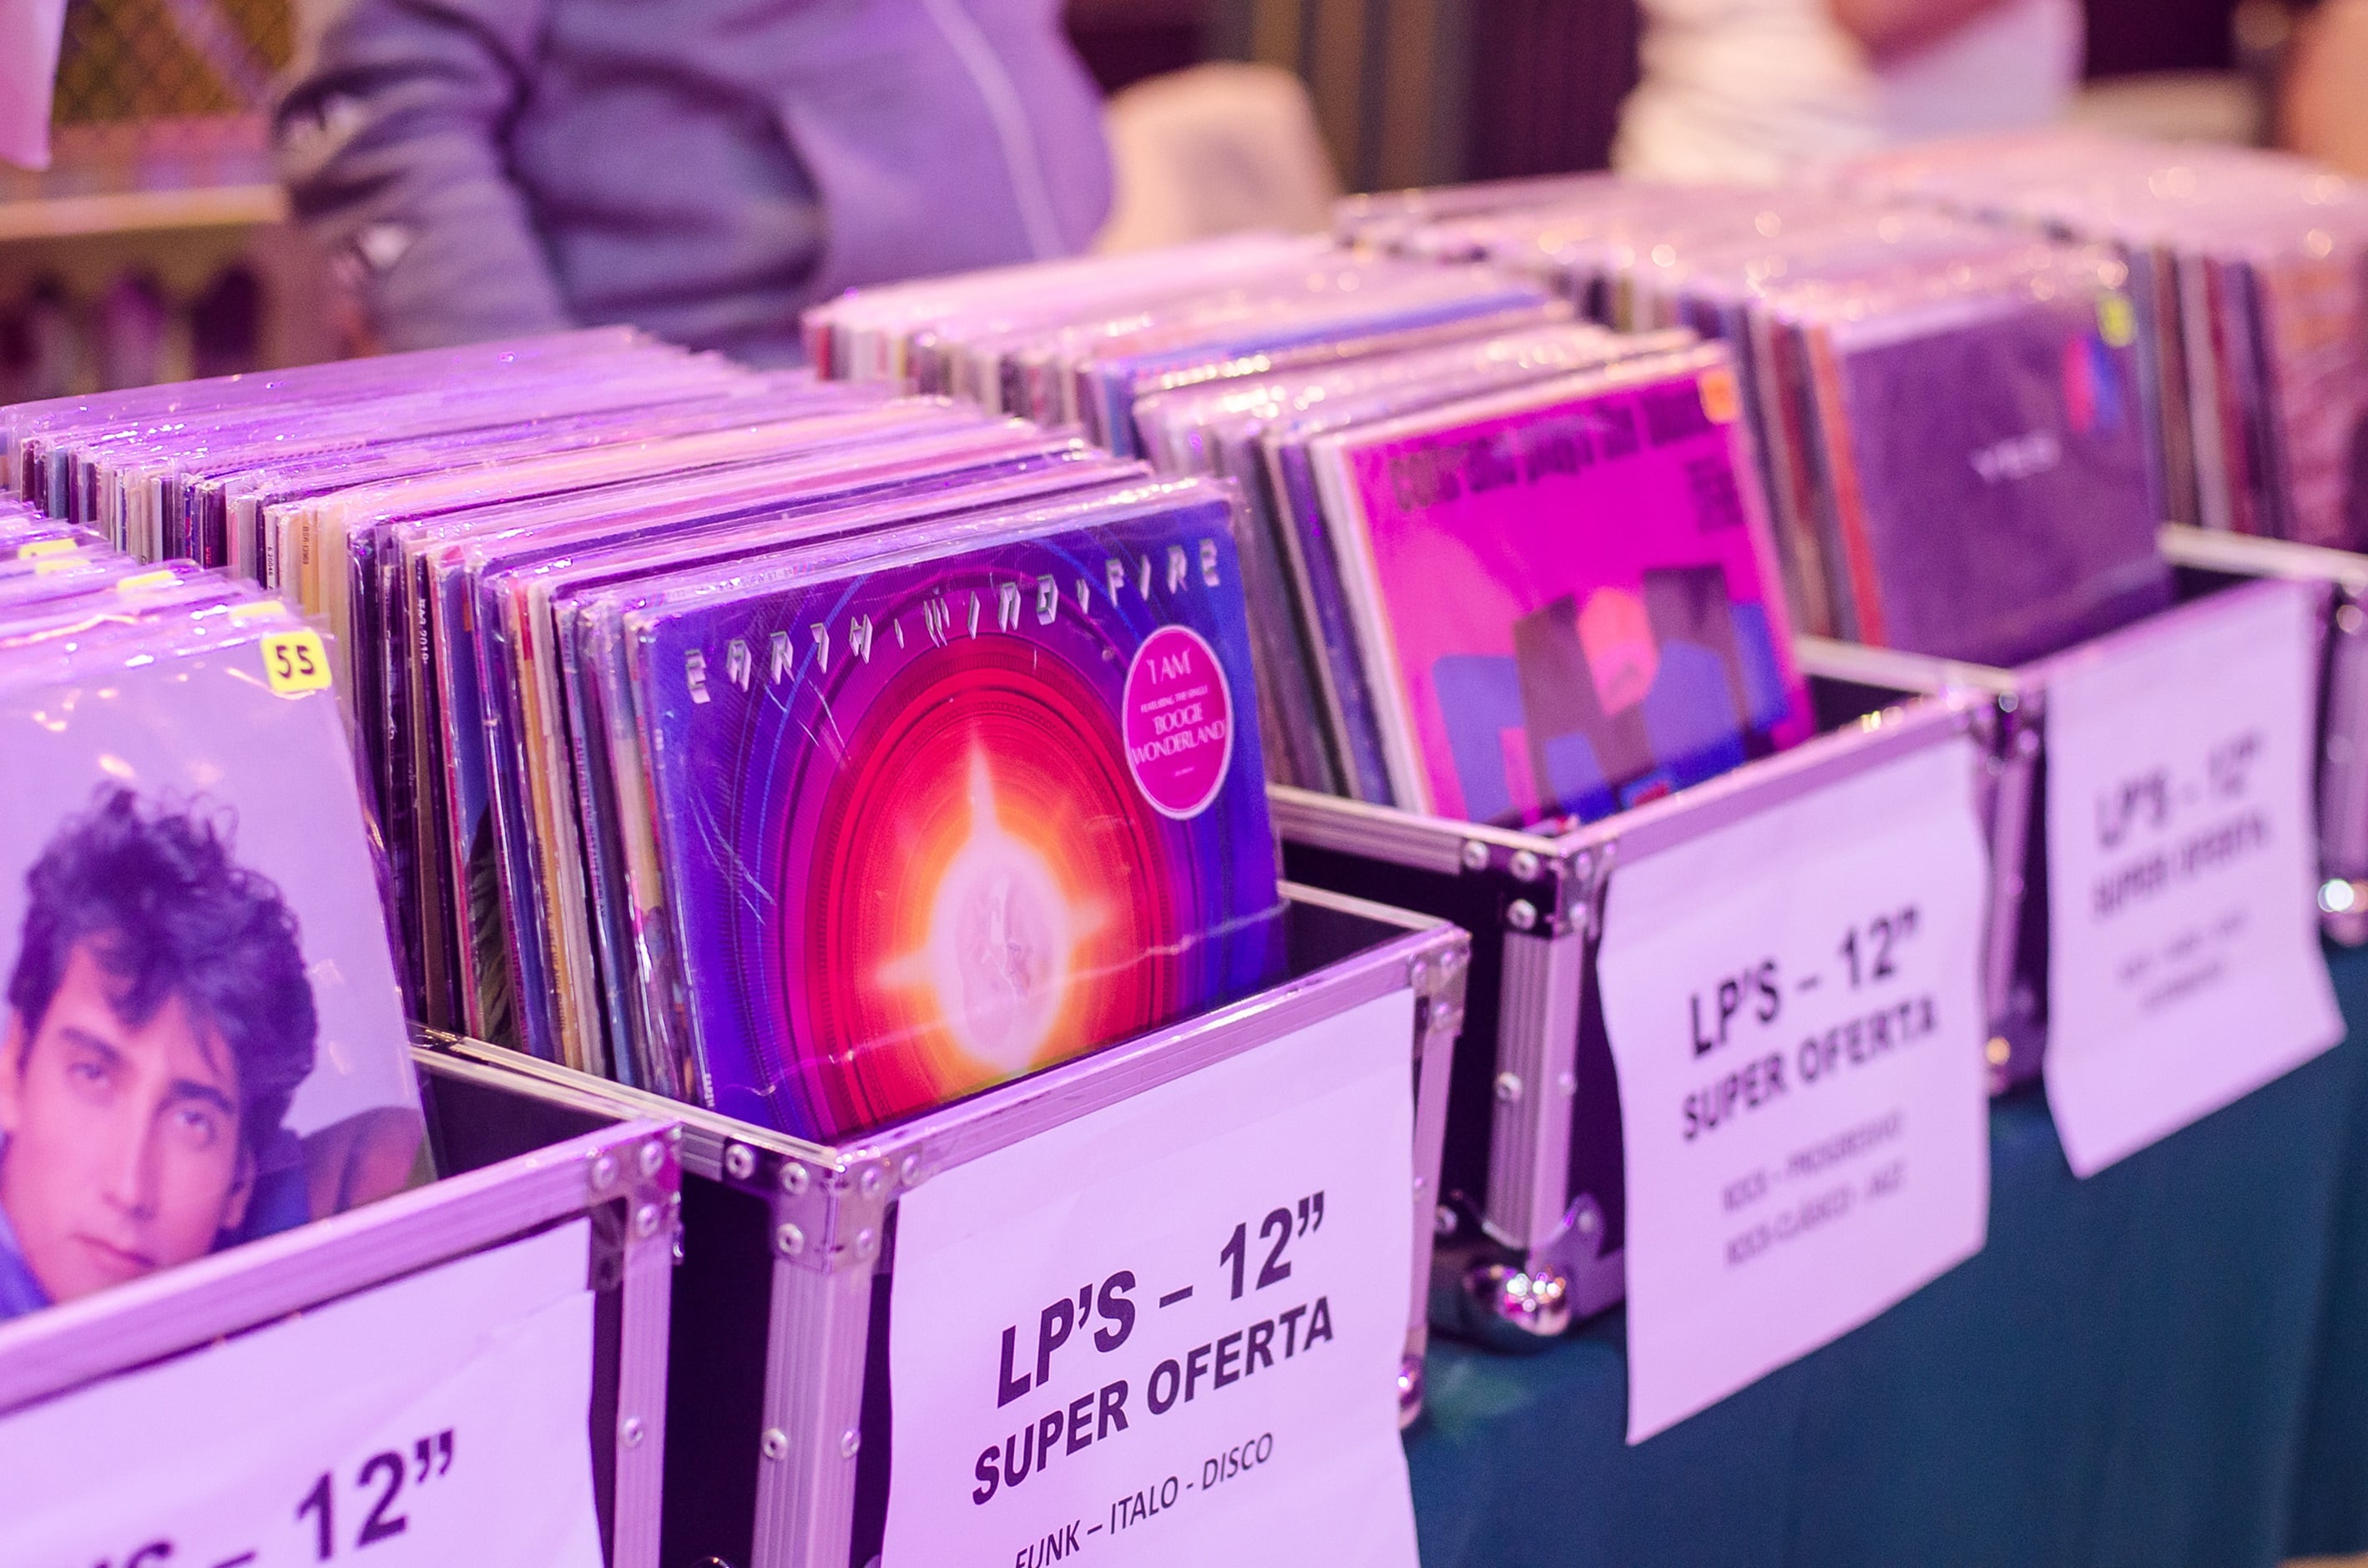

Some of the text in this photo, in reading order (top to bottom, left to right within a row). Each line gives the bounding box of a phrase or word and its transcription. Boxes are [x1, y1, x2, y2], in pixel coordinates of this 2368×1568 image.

[275, 645, 315, 678] 55
[684, 538, 1219, 704] EARTH WIND FIRE
[1683, 996, 1937, 1142] SUPER OFERTA
[1690, 960, 1780, 1060] LP'S
[997, 1270, 1136, 1409] LP'S
[1219, 1190, 1325, 1301] 12"
[972, 1295, 1333, 1505] SUPER OFERTA
[295, 1428, 455, 1562] 12"
[1014, 1519, 1081, 1568] FUNK
[1110, 1476, 1178, 1535] ITALO
[1201, 1432, 1274, 1491] DISCO
